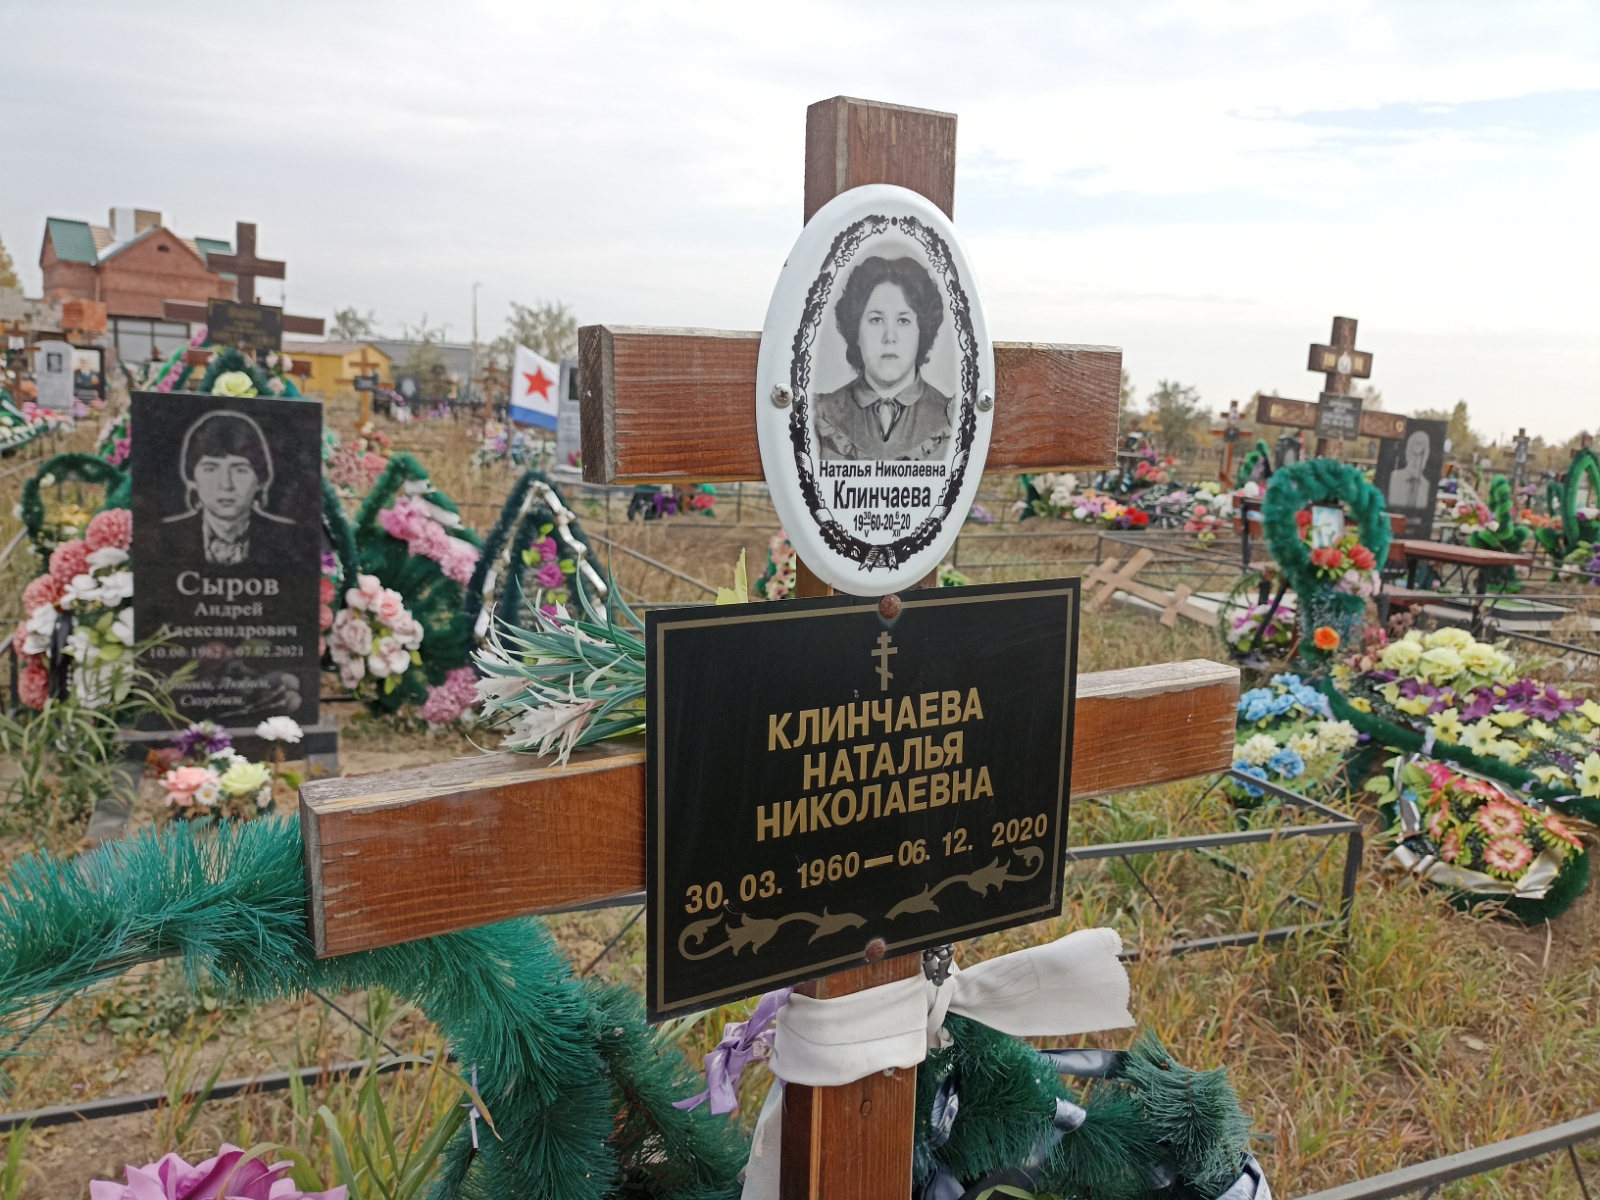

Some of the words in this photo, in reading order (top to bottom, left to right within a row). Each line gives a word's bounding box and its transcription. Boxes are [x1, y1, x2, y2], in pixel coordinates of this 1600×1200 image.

[819, 460, 872, 478] Наталья
[875, 460, 946, 477] Николаевна
[833, 480, 931, 509] Клинчаева
[176, 570, 280, 601] Сыров
[194, 601, 263, 619] Андрей
[767, 686, 984, 752] КЛИНЧАЕВА
[802, 731, 964, 790] НАТАЛЬЯ
[756, 766, 994, 842] НИКОЛАЕВНА
[685, 881, 729, 914] 30.
[739, 870, 783, 903] 03.
[942, 827, 973, 857] 12.
[991, 813, 1048, 848] 2020
